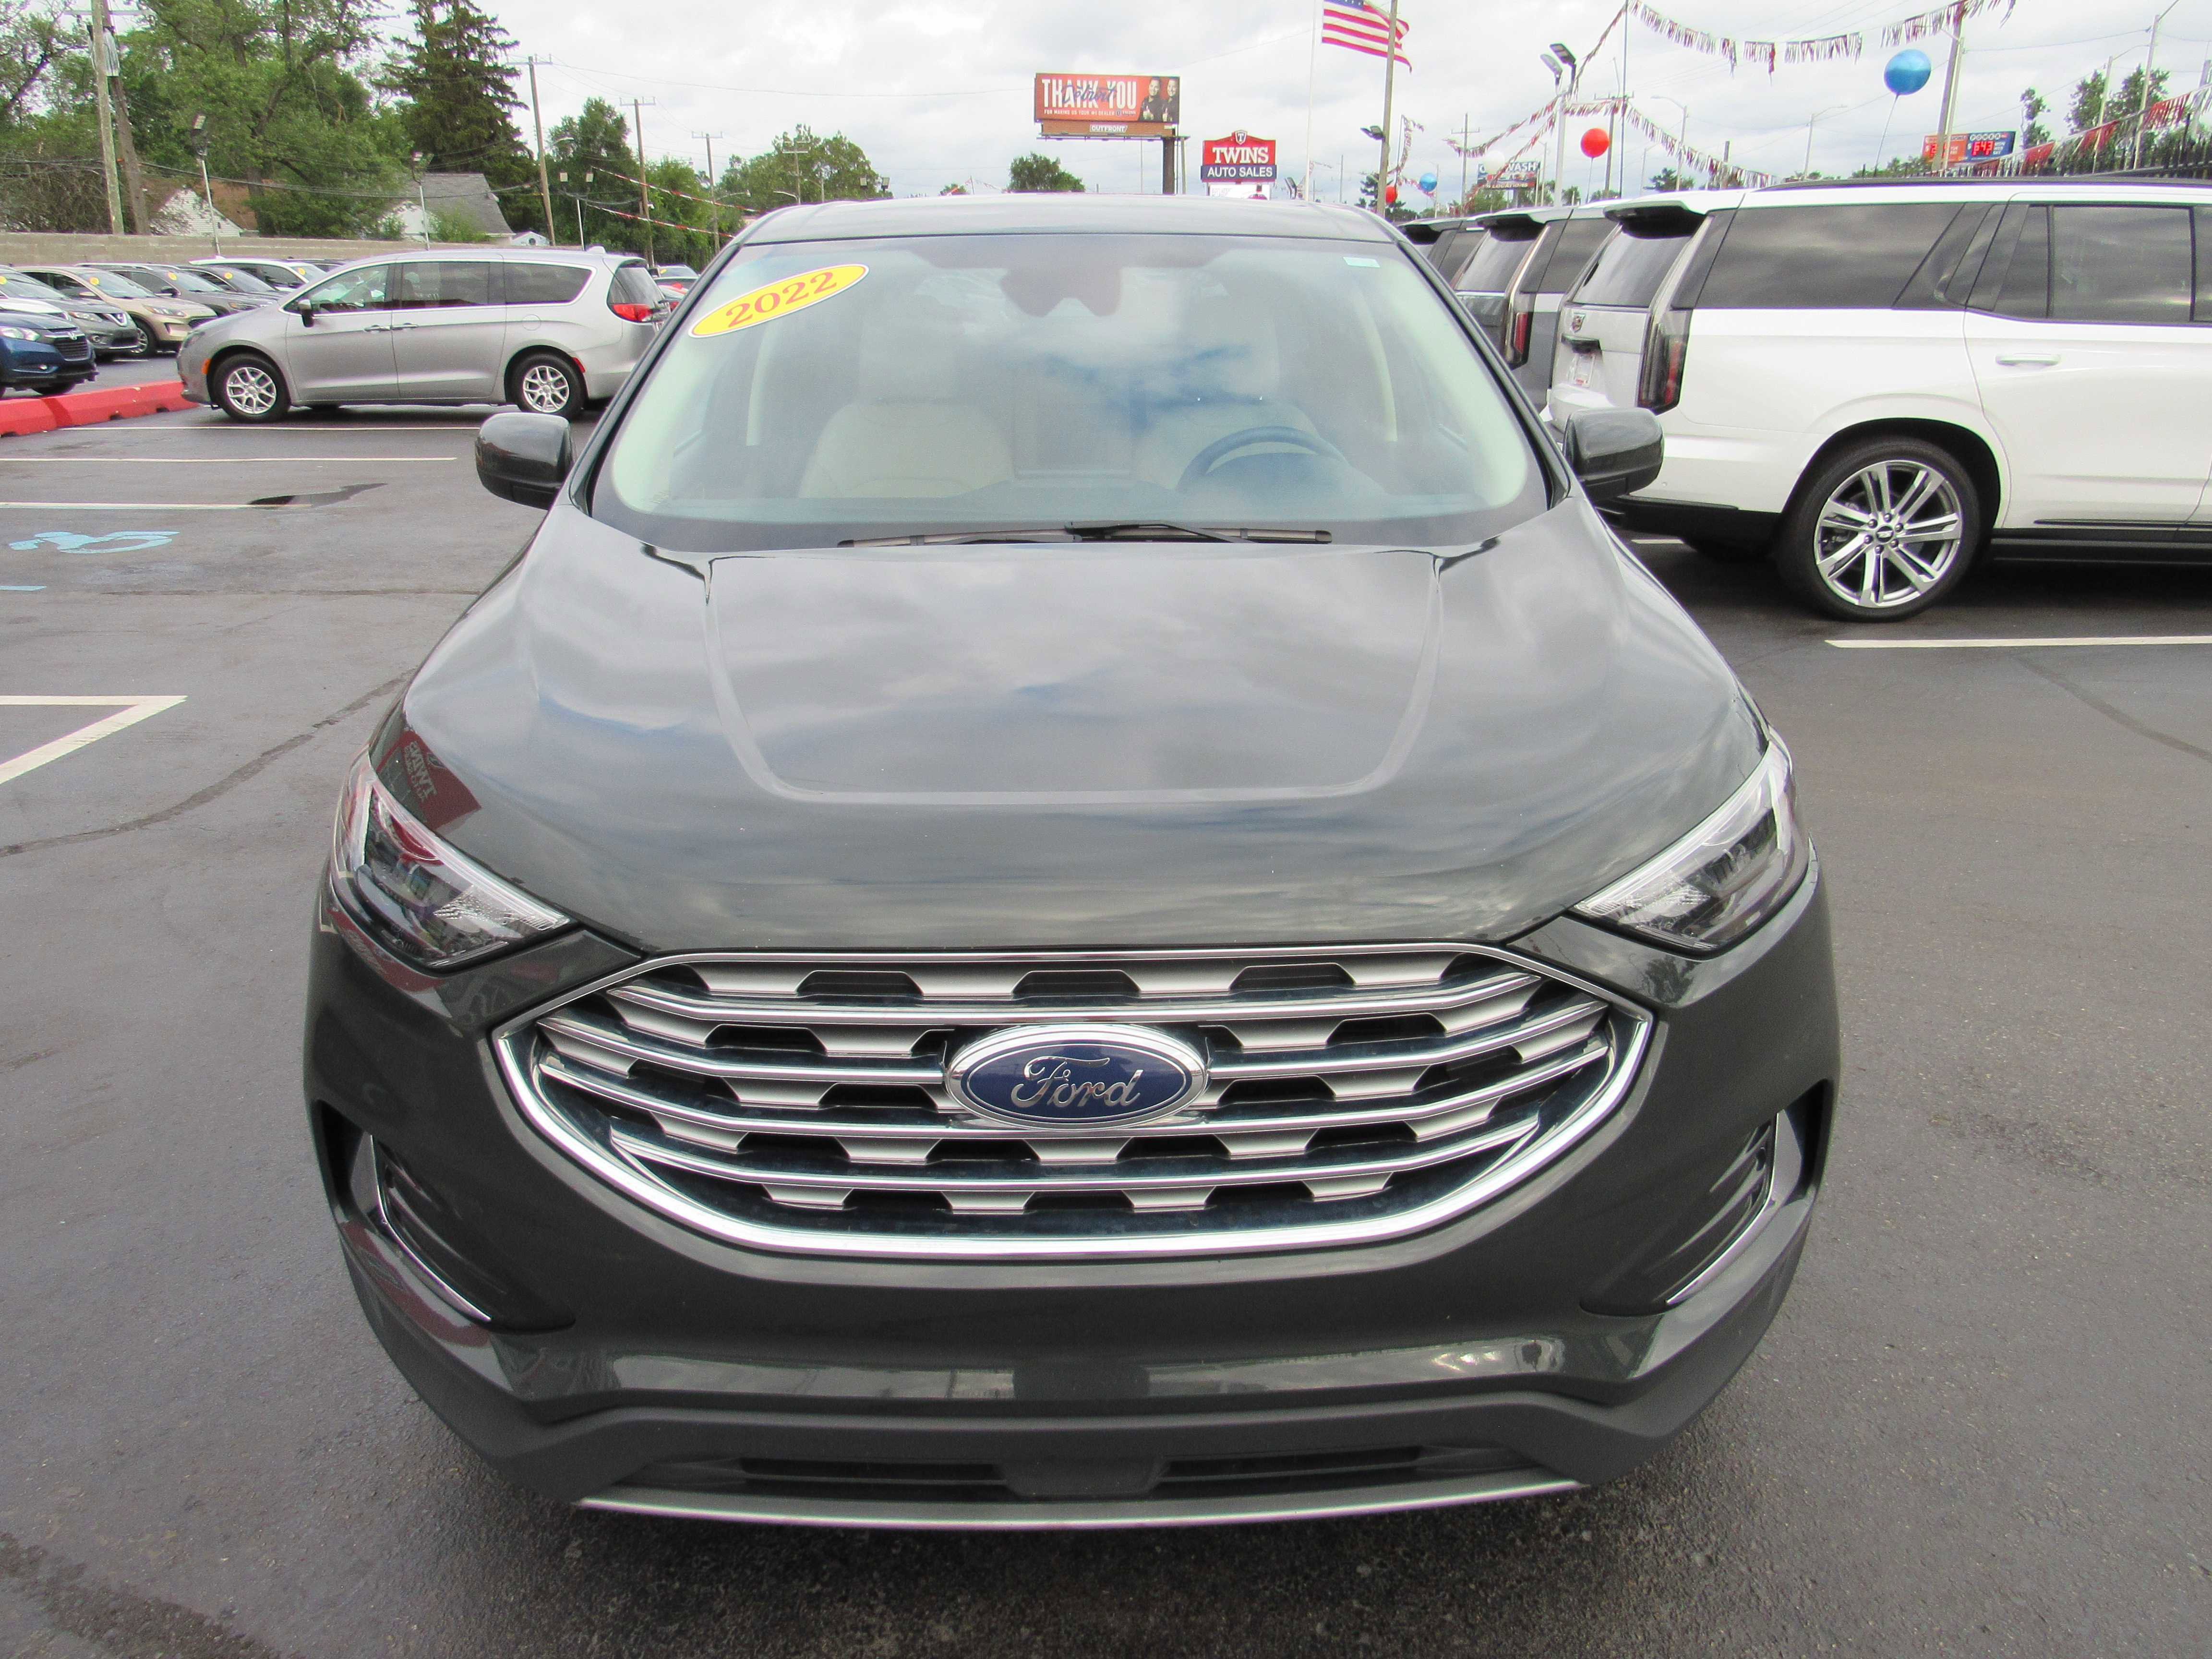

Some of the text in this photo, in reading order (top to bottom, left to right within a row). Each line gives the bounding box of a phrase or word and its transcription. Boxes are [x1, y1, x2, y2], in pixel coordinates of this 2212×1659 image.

[1041, 79, 1137, 109] THANK YOU
[1238, 133, 1244, 142] T
[1212, 146, 1269, 164] TWINS
[1207, 167, 1273, 178] AUTO SALES
[725, 272, 837, 327] 2022
[1010, 1055, 1144, 1108] Ford
